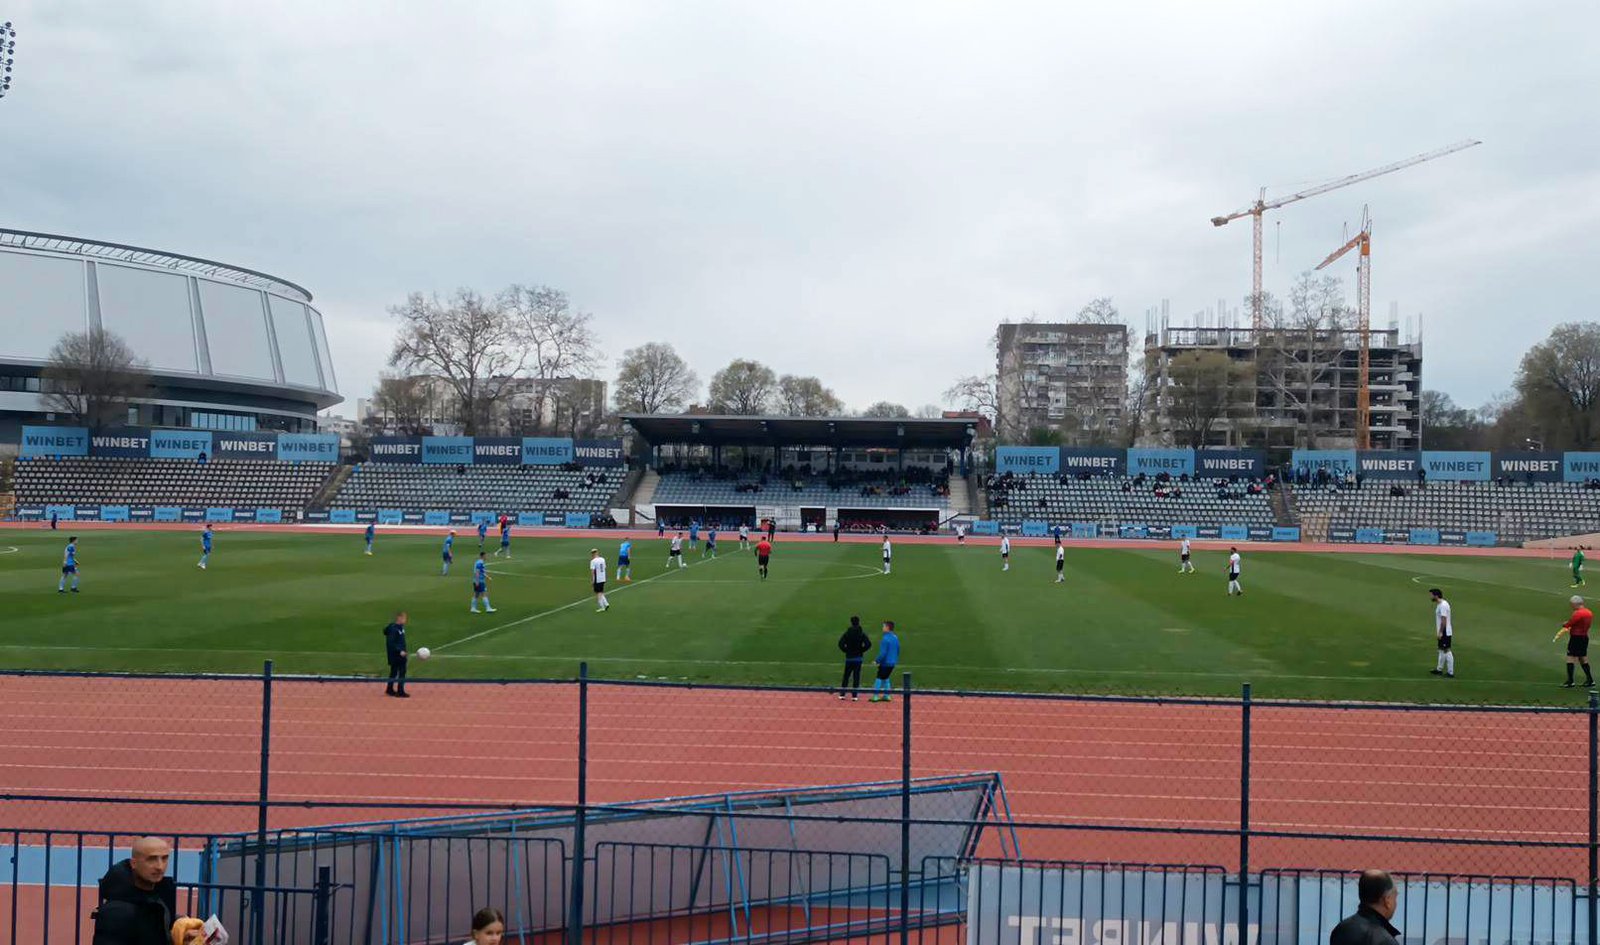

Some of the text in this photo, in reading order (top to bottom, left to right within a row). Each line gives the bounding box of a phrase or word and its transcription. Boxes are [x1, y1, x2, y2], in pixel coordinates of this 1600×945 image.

[26, 436, 83, 447] WINBET
[92, 437, 148, 448] WINBET
[155, 439, 208, 450] WINBET
[220, 440, 276, 452] WINBET
[282, 442, 334, 453] WINBET
[373, 444, 420, 454] WINBET
[426, 445, 472, 455] WINBET
[475, 445, 521, 456] WINBET
[525, 446, 570, 456] WINBET
[575, 447, 621, 458] WINBET
[1003, 456, 1052, 466] WINBET
[1067, 457, 1117, 468] WINBET
[1137, 458, 1187, 469] WINBET
[1203, 459, 1255, 470] WINBET
[1362, 460, 1415, 471] WINBET
[1429, 461, 1484, 472] WINBET
[1500, 460, 1559, 472] WINBET
